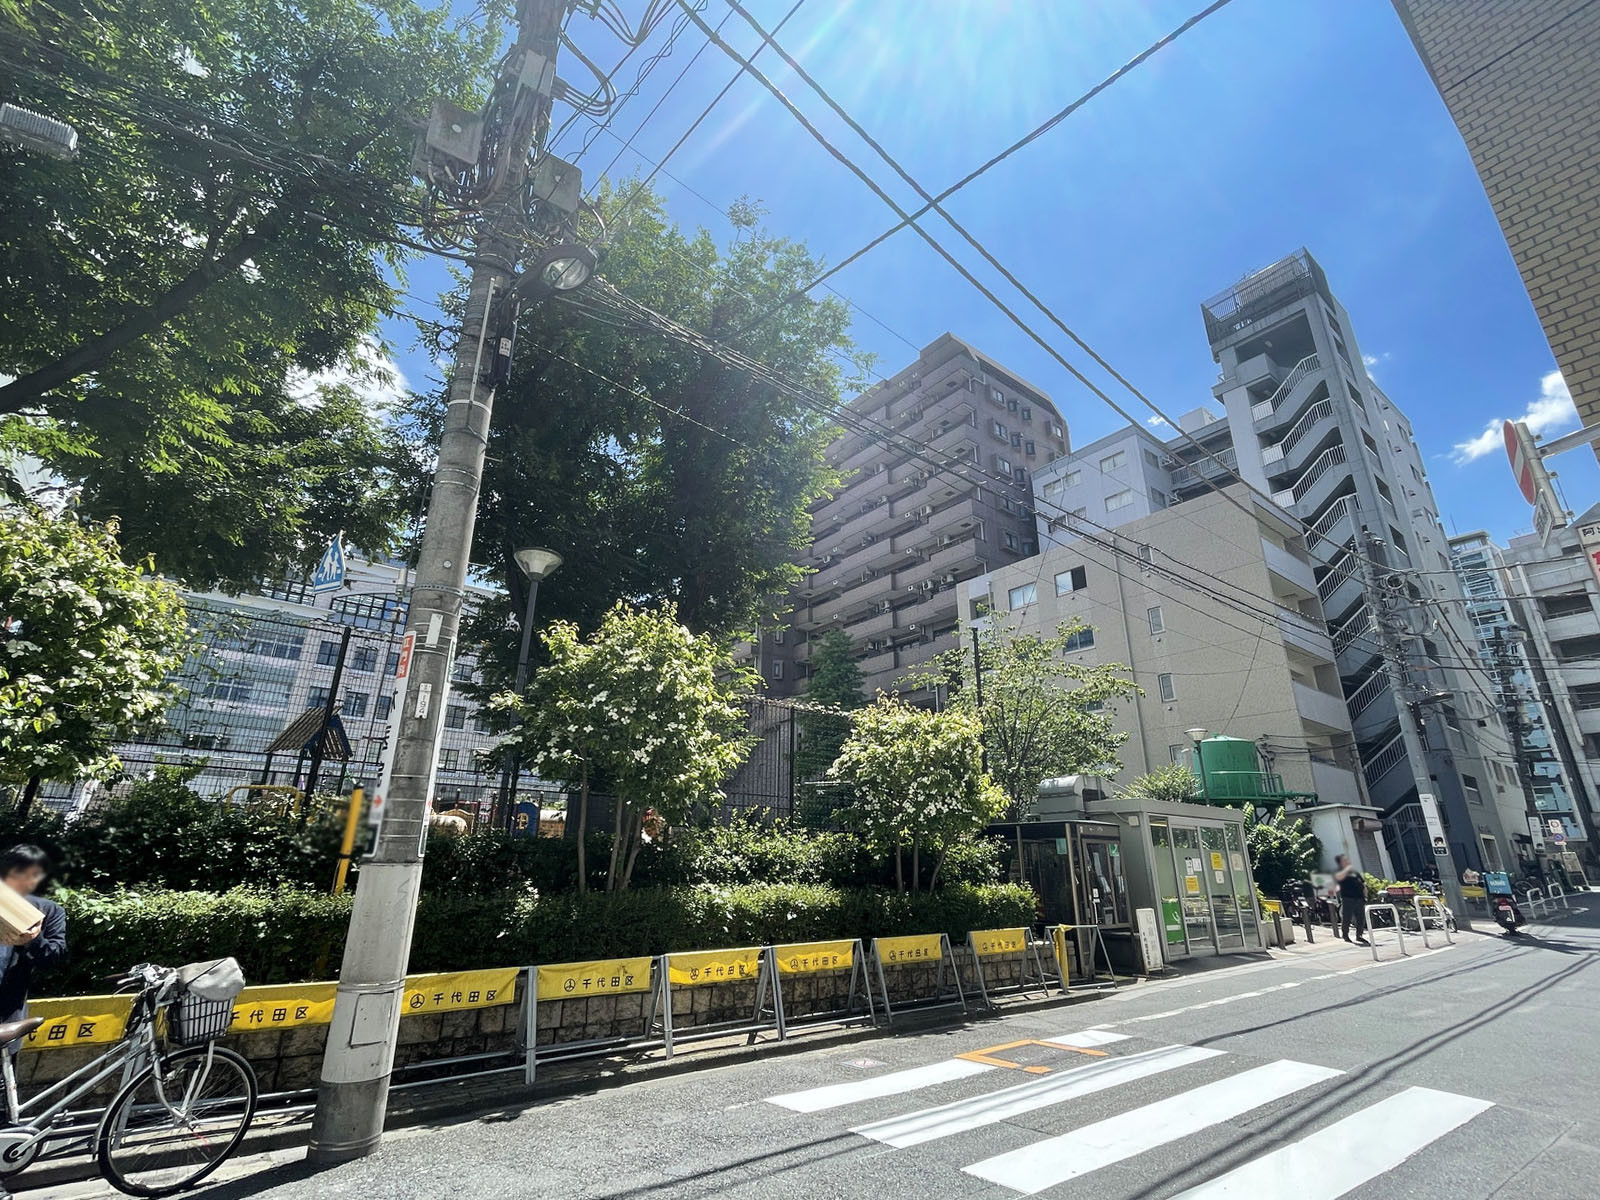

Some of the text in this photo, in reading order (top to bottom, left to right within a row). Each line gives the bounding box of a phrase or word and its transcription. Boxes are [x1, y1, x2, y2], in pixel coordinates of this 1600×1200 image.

[582, 976, 634, 989] 千代田区
[433, 990, 497, 1005] 千代田区
